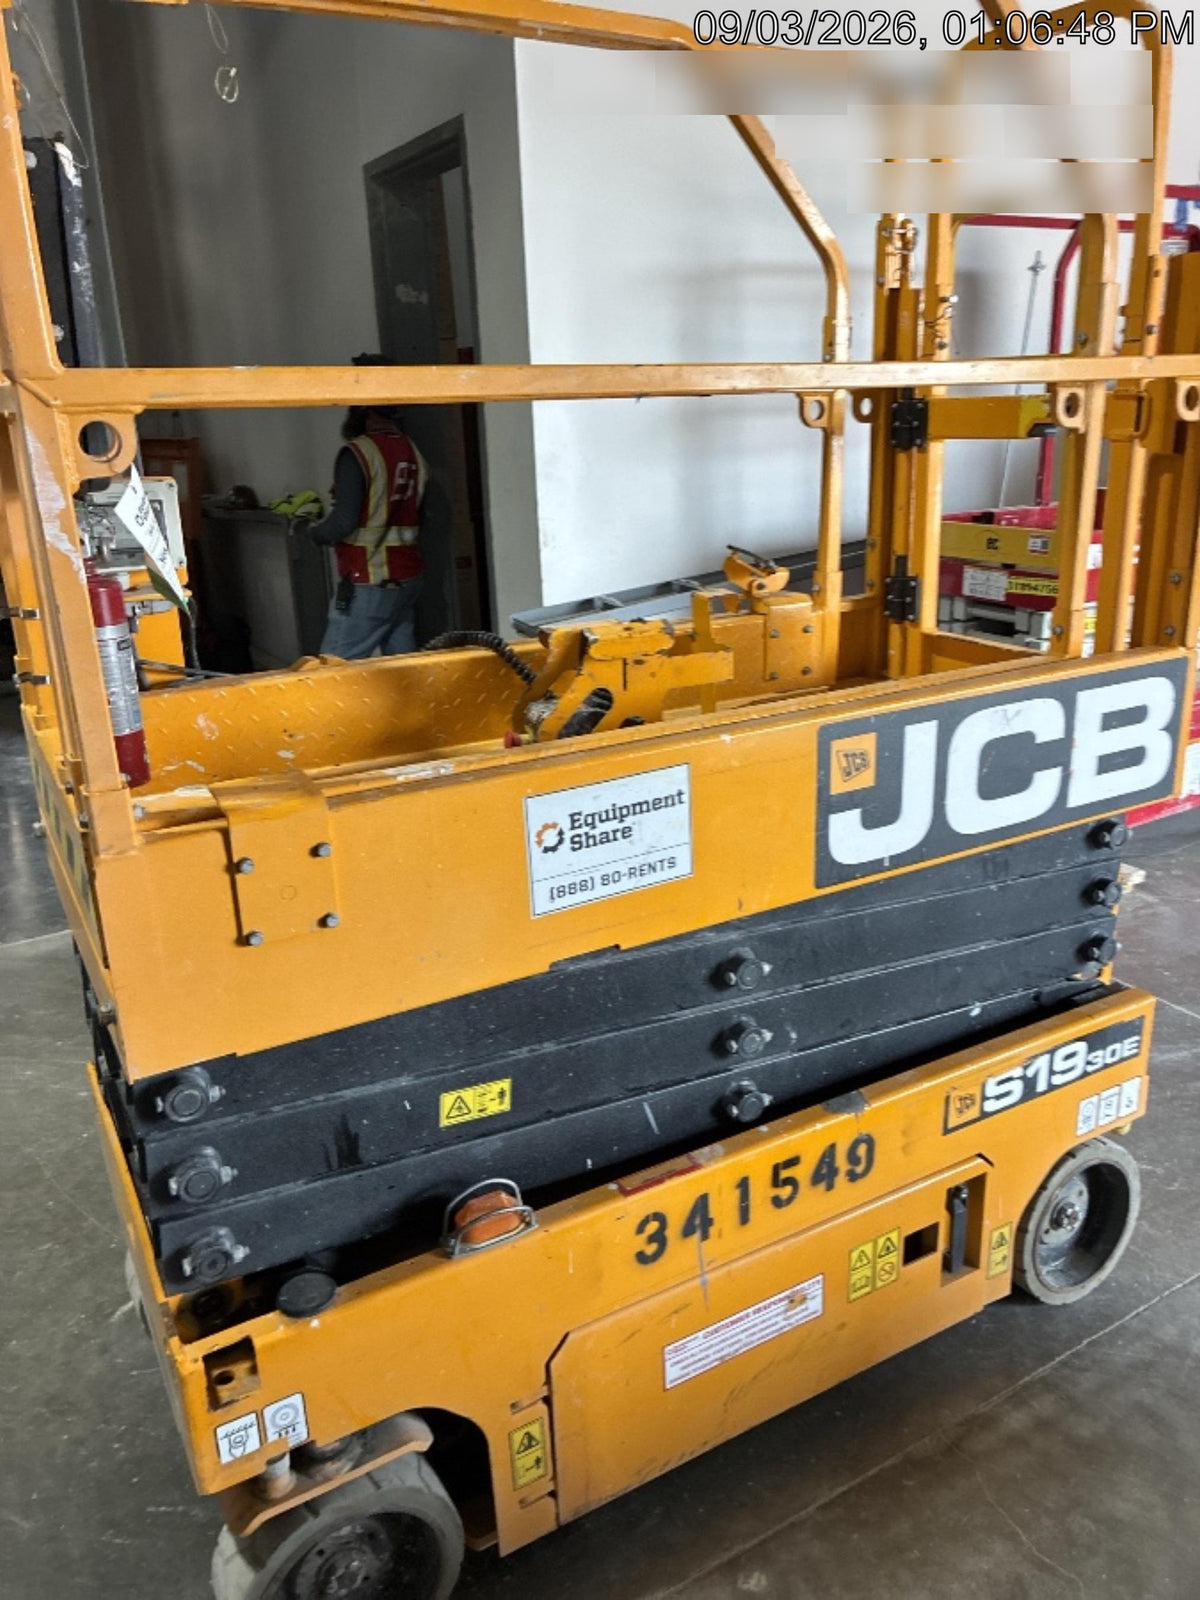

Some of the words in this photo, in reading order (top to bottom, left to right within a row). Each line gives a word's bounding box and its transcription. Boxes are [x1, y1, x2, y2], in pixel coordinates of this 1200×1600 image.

[828, 676, 1176, 866] JCB
[841, 750, 870, 779] JCB
[568, 789, 685, 831] Equipment
[569, 825, 633, 852] Share
[549, 877, 595, 903] (888)
[600, 856, 677, 887] 80-RENTS
[634, 1133, 876, 1266] 341549
